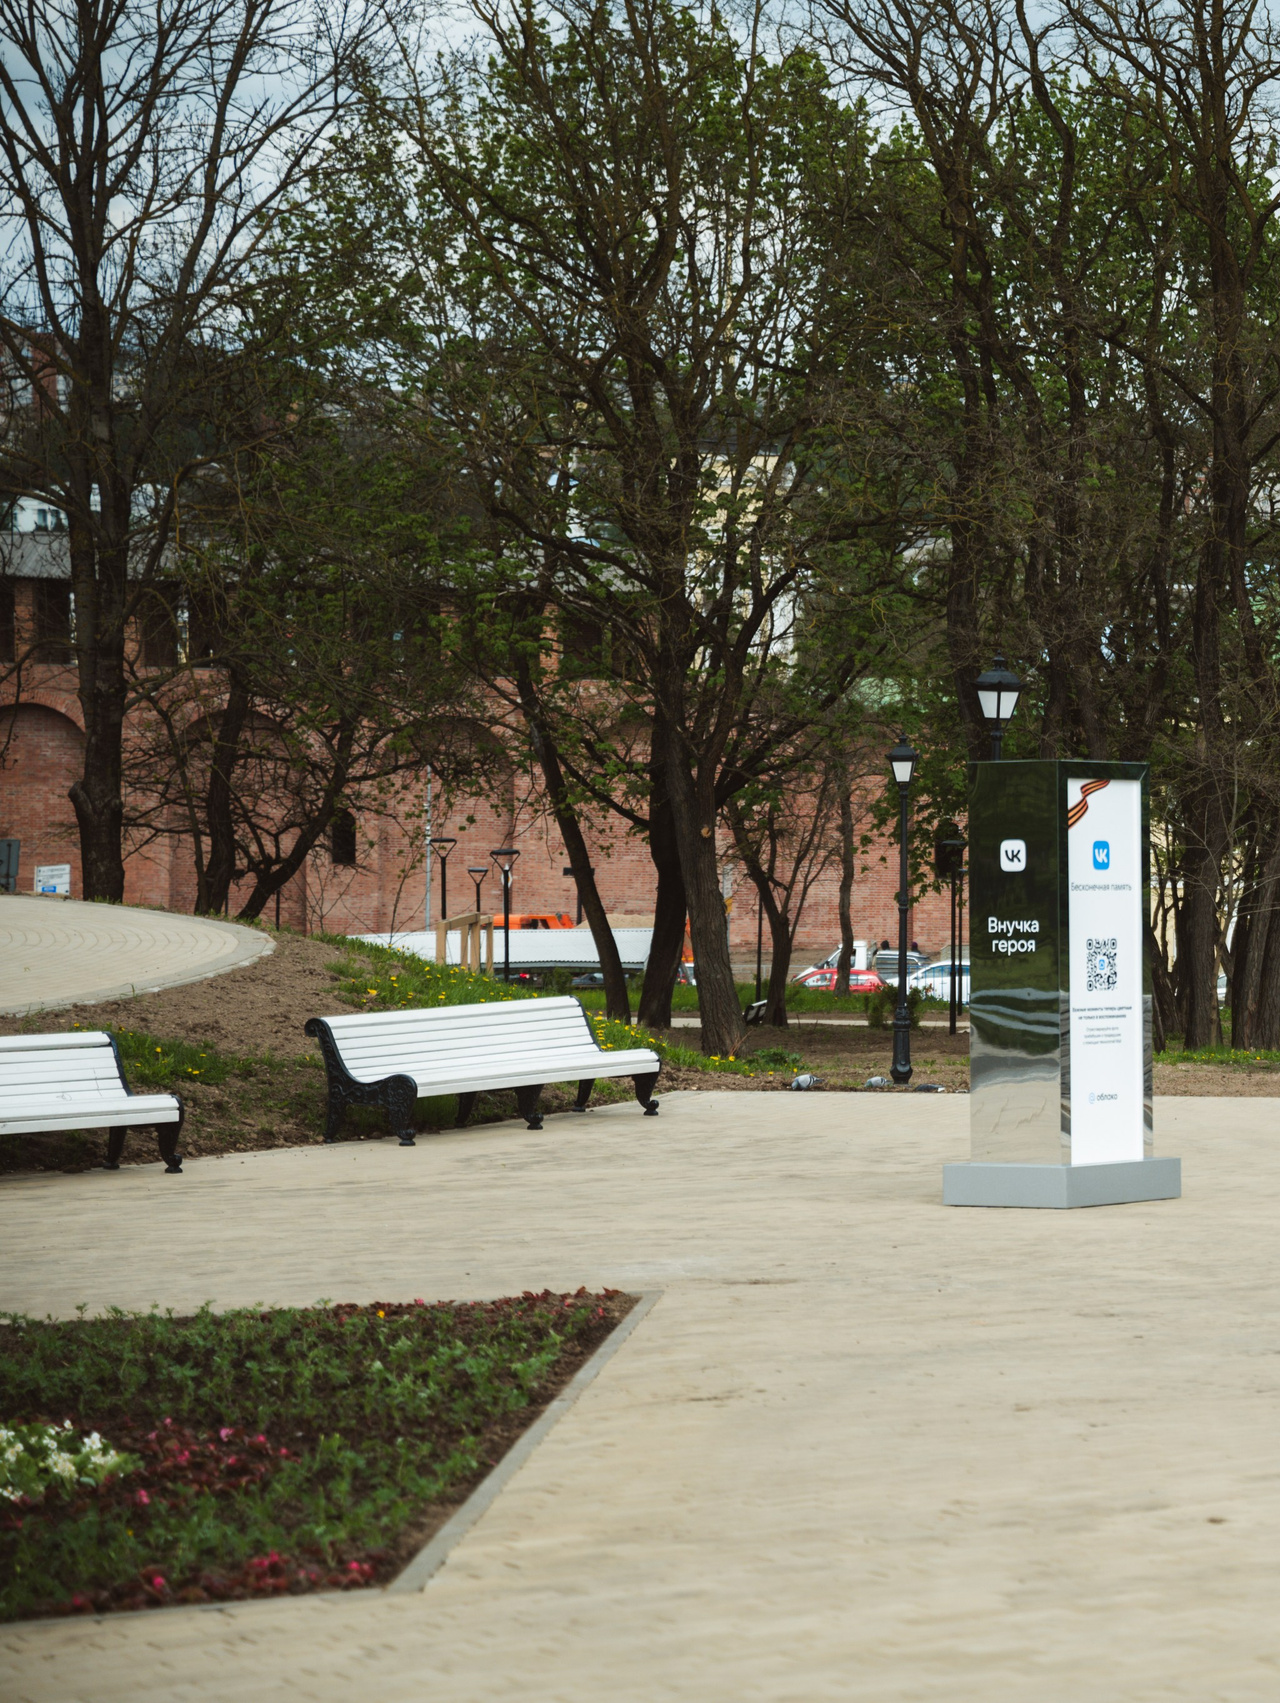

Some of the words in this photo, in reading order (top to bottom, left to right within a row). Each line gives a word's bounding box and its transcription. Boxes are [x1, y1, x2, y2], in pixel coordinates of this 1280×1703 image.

[1005, 850, 1021, 863] VK
[1094, 848, 1108, 863] VK
[1071, 882, 1110, 892] Бесконечная
[988, 916, 1040, 937] Внучка
[992, 940, 1036, 956] героя
[1096, 1092, 1118, 1101] облако
